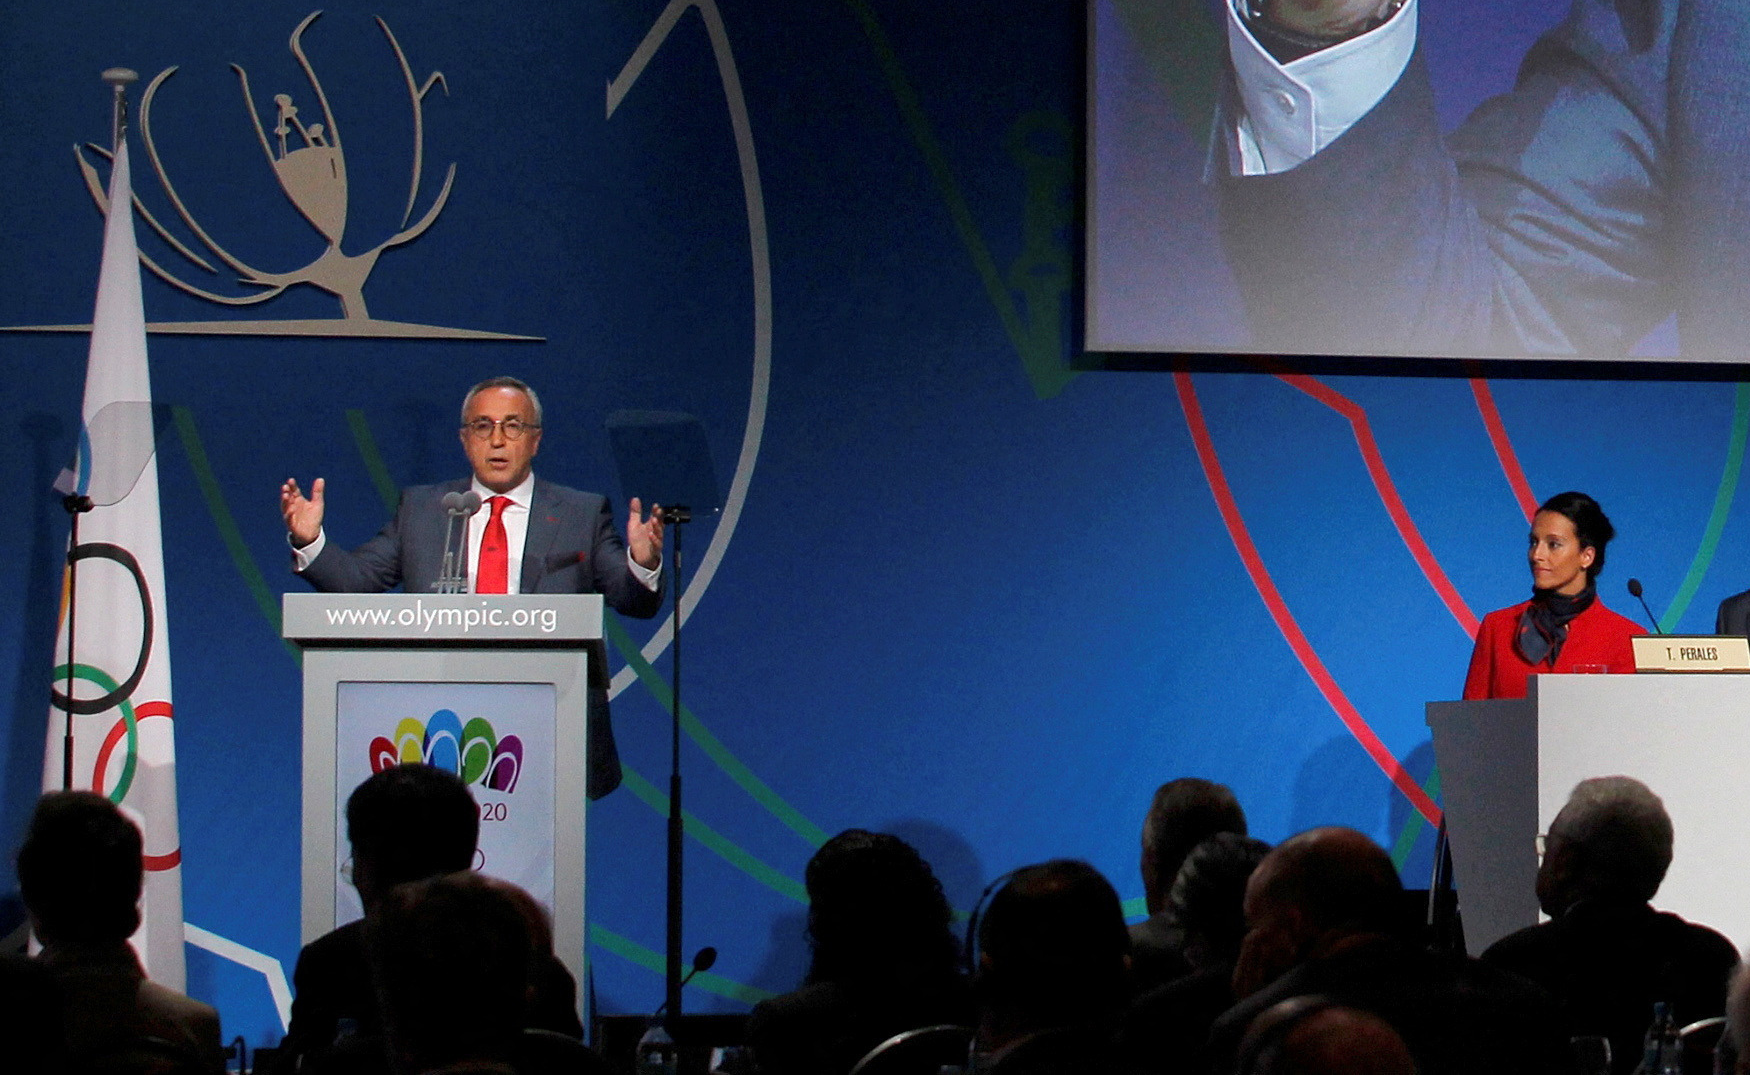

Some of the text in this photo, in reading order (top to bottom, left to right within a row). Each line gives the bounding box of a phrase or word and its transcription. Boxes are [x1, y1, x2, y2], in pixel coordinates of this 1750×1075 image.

[325, 599, 557, 633] www.olympic.org
[1666, 647, 1718, 661] T. PERALES
